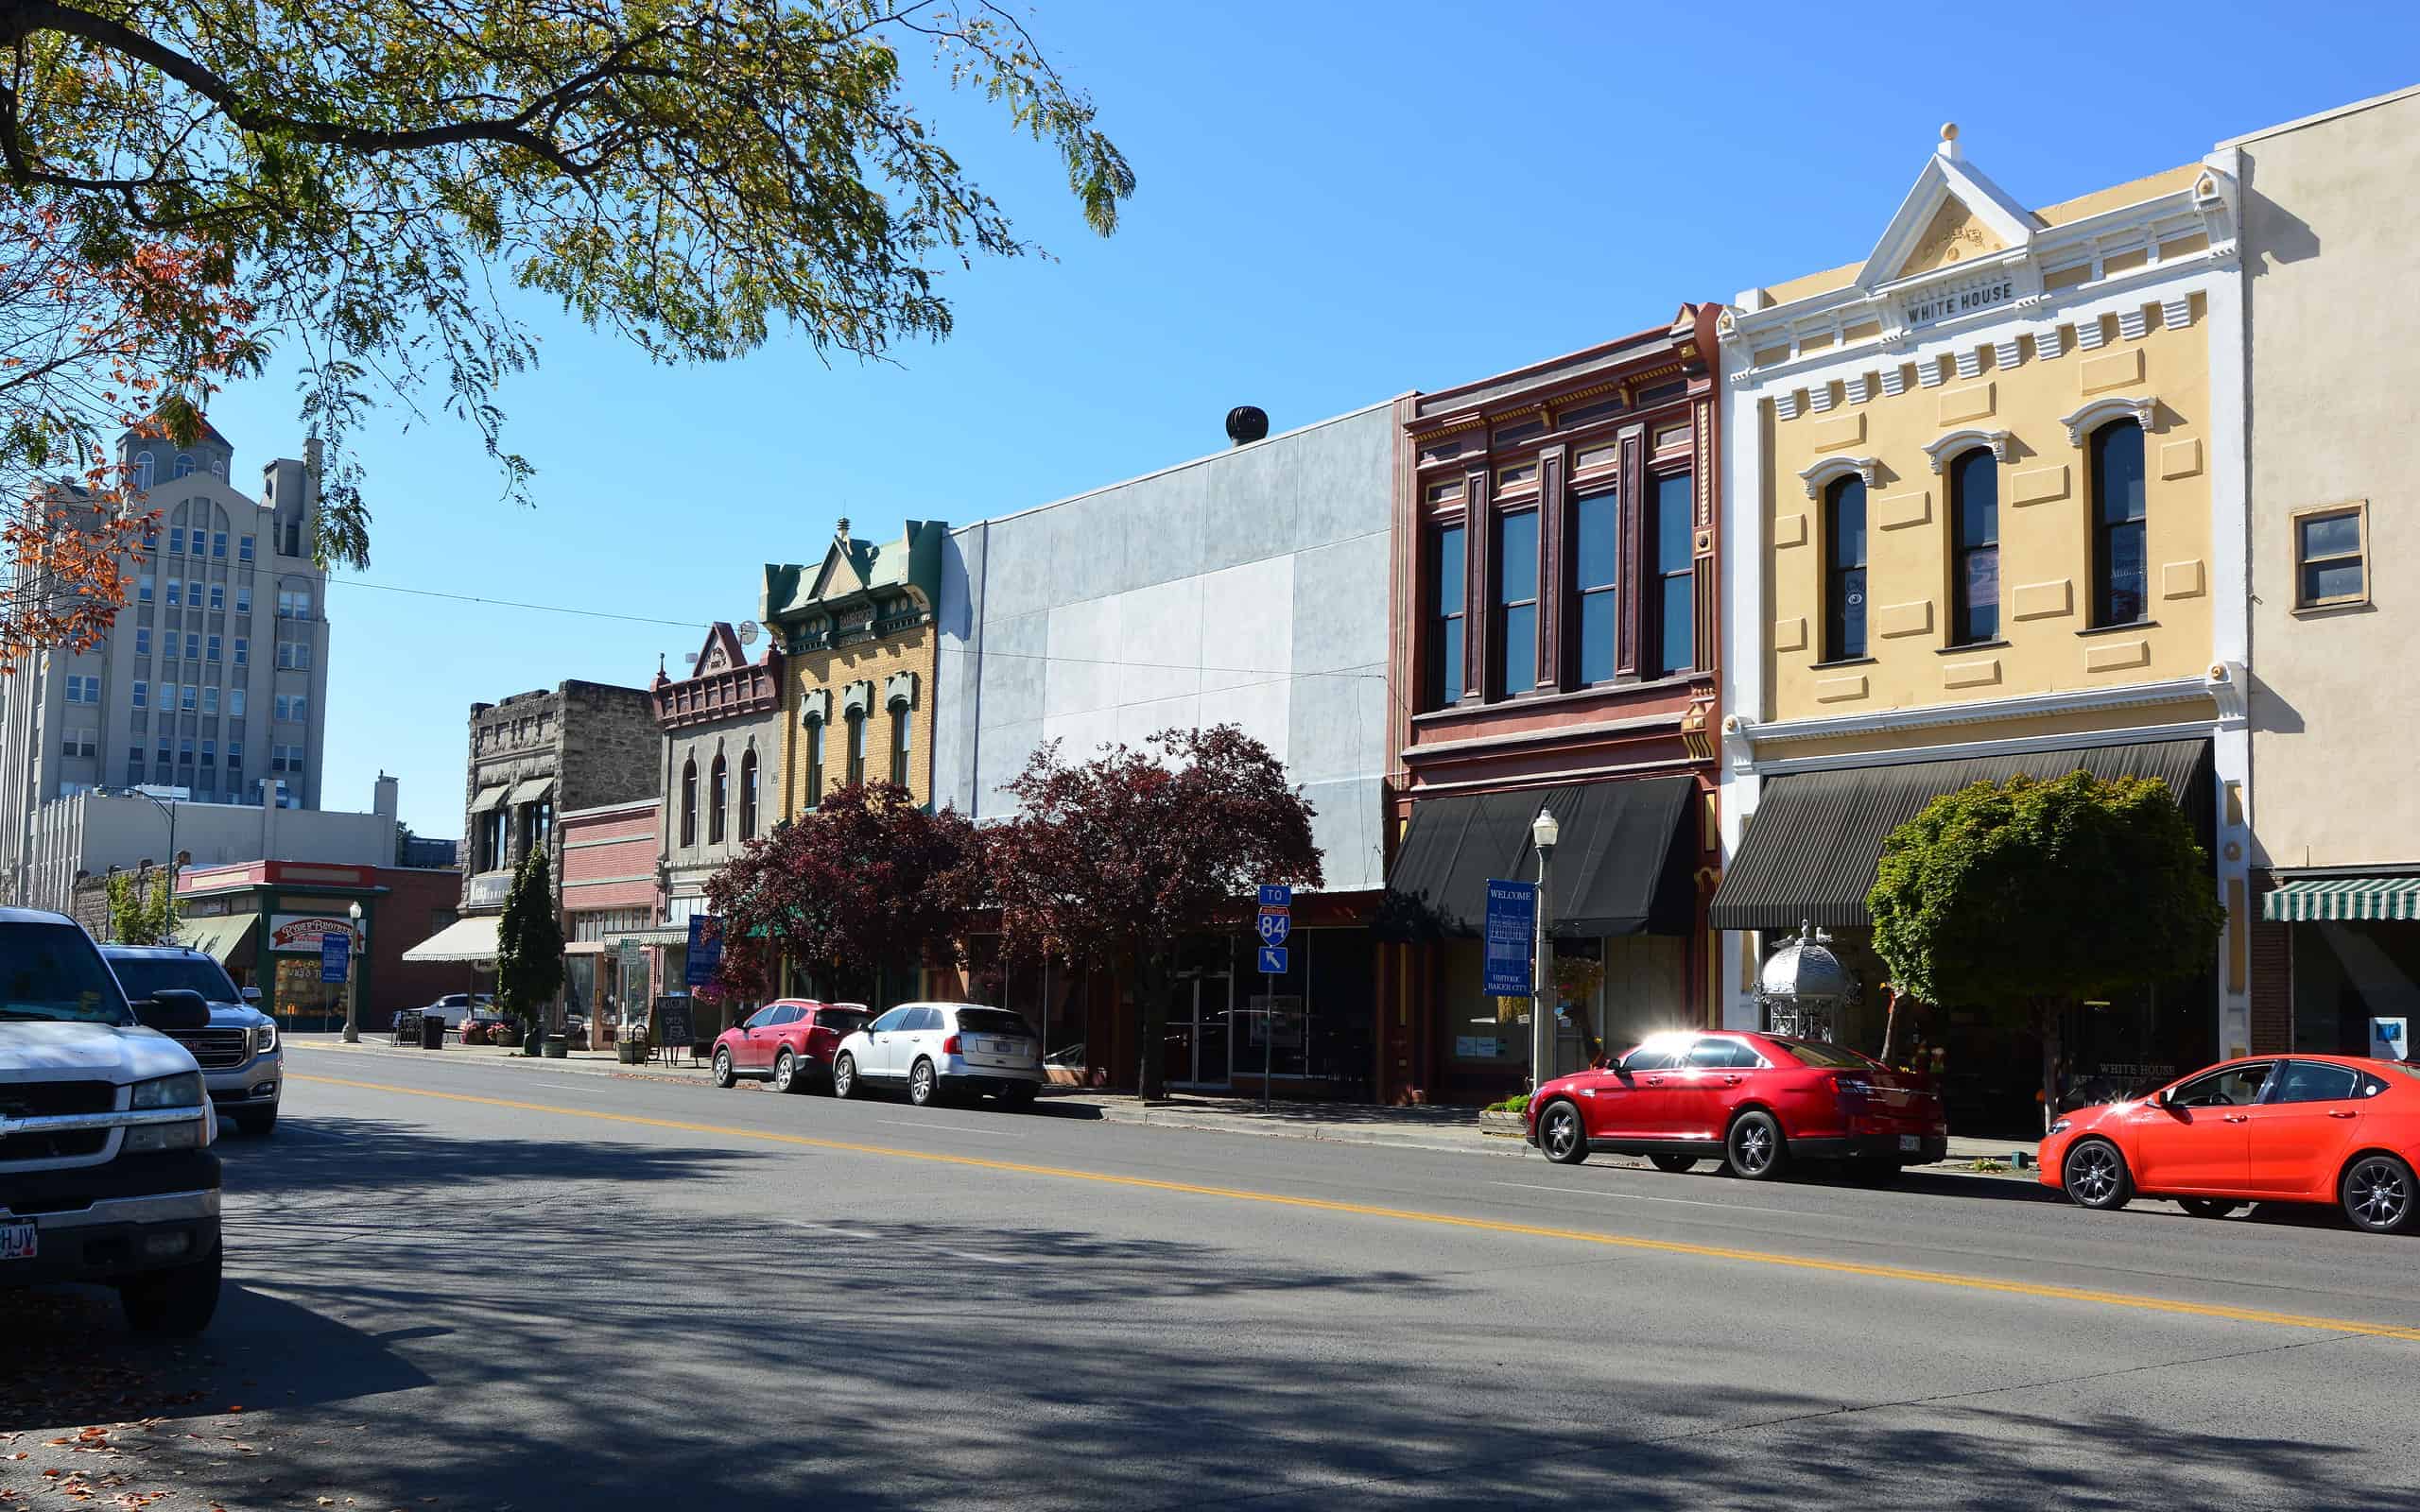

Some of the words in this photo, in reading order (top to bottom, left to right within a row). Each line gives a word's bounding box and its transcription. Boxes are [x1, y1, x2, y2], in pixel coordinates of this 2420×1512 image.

[1908, 299, 1955, 323] WHITE
[1961, 283, 2013, 310] HOUSE
[1267, 889, 1282, 901] TO
[1491, 889, 1531, 901] WELCOME
[1262, 917, 1287, 938] 84
[1489, 983, 1511, 991] BAKER
[2100, 1064, 2137, 1074] WHITE
[2140, 1065, 2175, 1075] HOUSE
[1, 1228, 33, 1249] HJV
